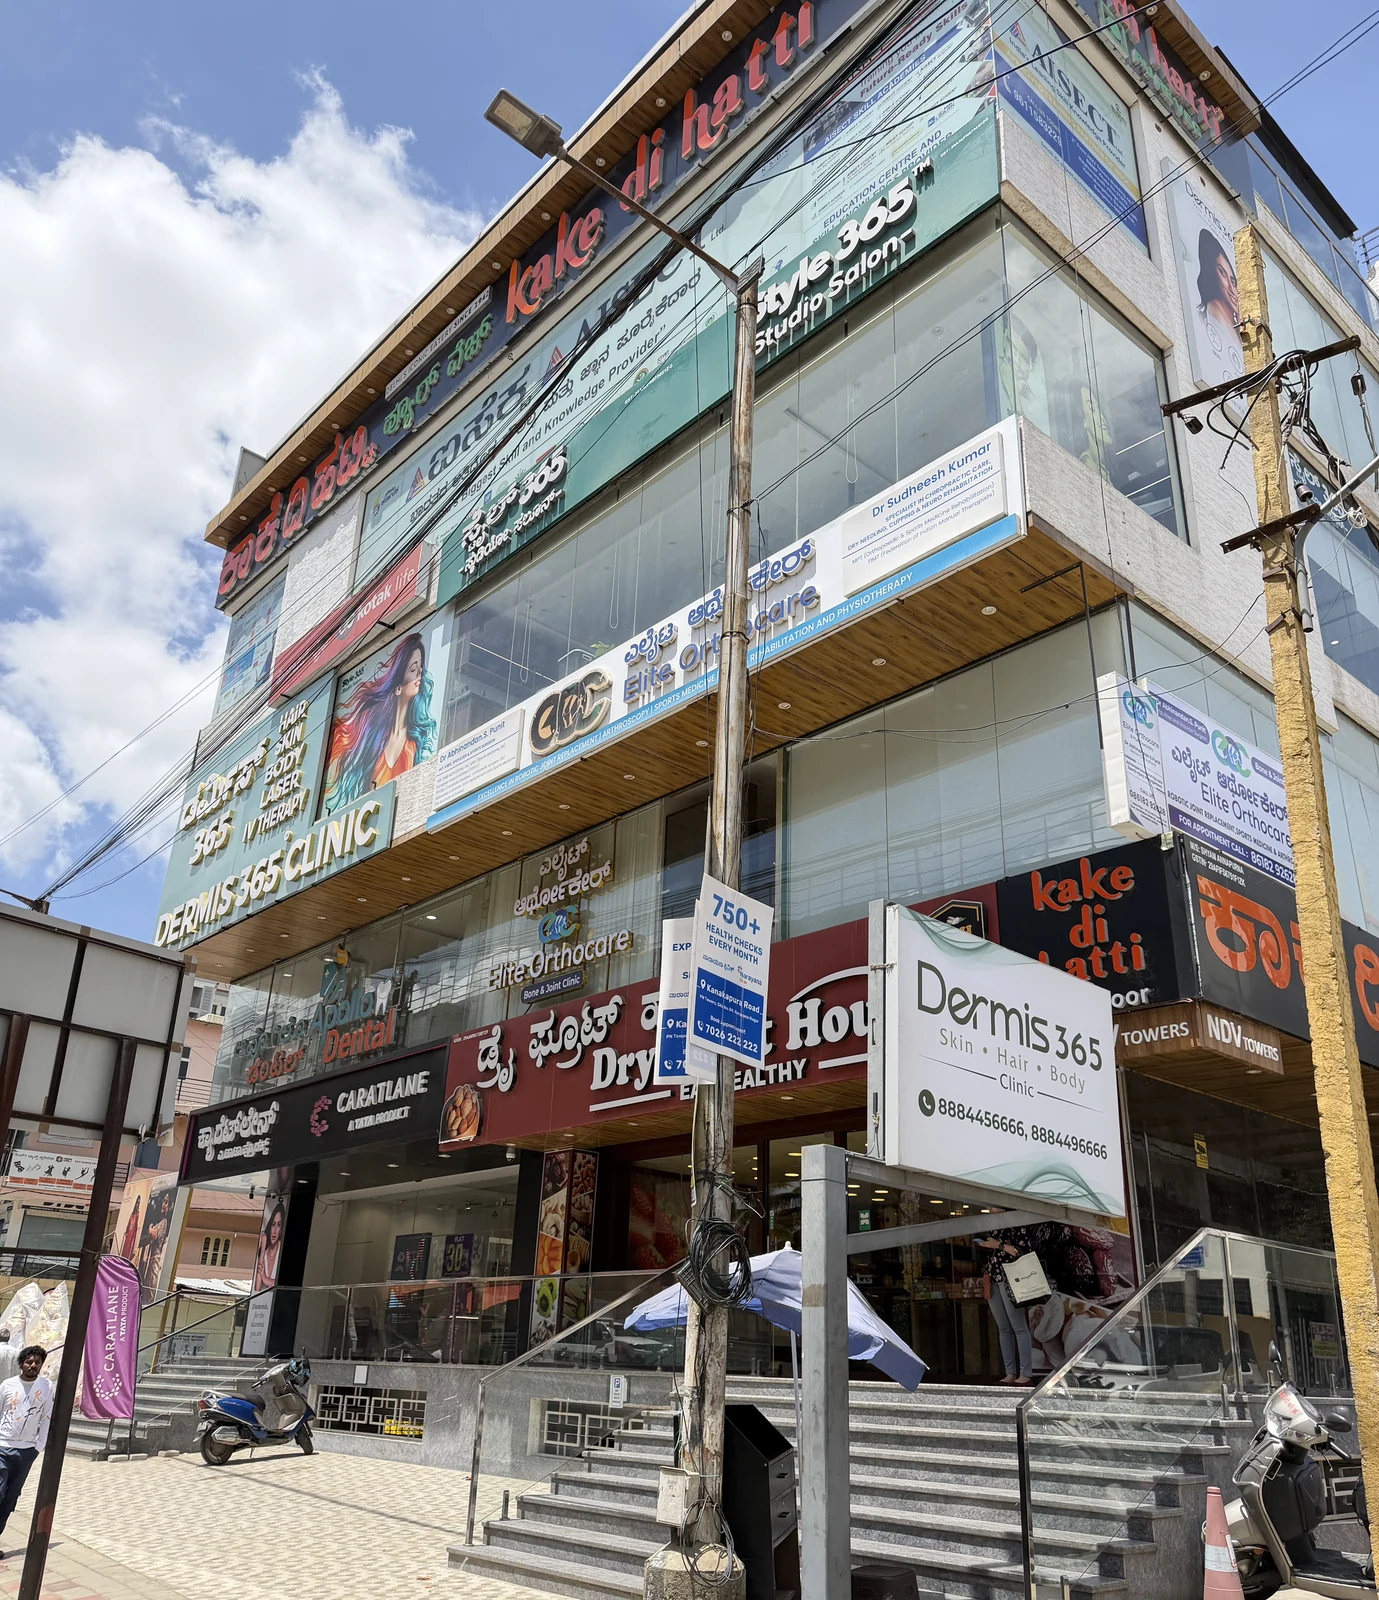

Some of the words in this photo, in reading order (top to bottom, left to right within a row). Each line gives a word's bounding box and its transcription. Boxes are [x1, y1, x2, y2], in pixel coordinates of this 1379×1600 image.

[824, 118, 852, 145] AISECT
[853, 98, 876, 121] SKILL
[877, 53, 926, 100] ACADEMIES
[1031, 43, 1117, 148] AISECT
[506, 207, 603, 323] kake
[620, 127, 665, 212] di
[682, 0, 814, 160] hatti
[823, 180, 876, 229] EDUCATION
[878, 150, 918, 185] CENTRE
[919, 129, 942, 152] AND
[834, 177, 918, 262] 365
[453, 307, 473, 329] SINCE
[522, 433, 542, 451] and
[544, 379, 605, 435] Knowledge
[871, 503, 885, 518] Dr
[887, 467, 946, 509] Sudheesh
[948, 441, 992, 474] Kumar
[885, 502, 917, 523] SPECIALIST
[917, 497, 924, 506] IN
[924, 470, 971, 500] CHIROPRACTIC
[847, 540, 859, 551] DRY
[888, 511, 915, 528] CUPPING
[922, 494, 943, 510] NEURO
[943, 465, 994, 498] REHABILITATION
[905, 522, 923, 537] Sports
[924, 507, 951, 526] Medicine
[938, 511, 961, 527] Manual
[624, 662, 673, 702] Elite
[679, 585, 817, 670] Ortocare
[477, 783, 508, 802] EXCELLENCE
[514, 765, 540, 783] ROBOTIC
[557, 735, 599, 761] REPLACEMENT
[601, 707, 650, 743] ARTHROSCOPY
[653, 692, 681, 713] SPORTS
[681, 674, 716, 698] MEDICINE
[749, 622, 815, 663] REHABILITATION
[816, 613, 832, 630] AND
[836, 571, 914, 622] PHYSIOTHERAPY
[279, 700, 309, 734] HAIR
[489, 720, 506, 736] Punit
[276, 723, 304, 757] SKIN
[264, 743, 307, 785] BODY
[1254, 762, 1267, 776] Bone
[260, 770, 305, 810] LASER
[1167, 790, 1189, 810] ROBOTIC
[1189, 800, 1204, 816] JOINT
[242, 821, 258, 844] IV
[258, 788, 310, 835] THERAPY
[1201, 782, 1229, 814] Elite
[1232, 800, 1292, 847] Orthocare
[189, 809, 235, 866] 365
[1178, 814, 1192, 828] FOR
[1192, 819, 1230, 849] APPOITMENT
[1250, 851, 1274, 874] 86182
[154, 875, 238, 948] DERMIS
[234, 849, 285, 908] 365
[284, 800, 381, 882] CLINIC
[1030, 857, 1135, 912] kake
[712, 893, 761, 935] 750+
[1068, 903, 1108, 948] di
[705, 921, 733, 942] HEALTH
[734, 934, 763, 956] CHECKS
[708, 935, 732, 954] EVERY
[733, 946, 759, 965] MONTH
[486, 961, 526, 992] Elite
[529, 929, 631, 978] Orthocare
[739, 970, 763, 987] Narayana
[523, 989, 540, 1000] Bone
[545, 980, 561, 994] Joint
[562, 974, 581, 988] Clinic
[706, 982, 743, 1008] Kanakapura
[743, 1000, 760, 1015] Road
[308, 988, 374, 1044] Apollo
[323, 1007, 396, 1064] Dental
[710, 1014, 721, 1026] Book
[917, 959, 1051, 1054] Dermis
[1055, 1024, 1103, 1072] 365
[1120, 1021, 1190, 1047] TOWERS
[705, 1024, 726, 1040] 7026
[727, 1031, 742, 1047] 222
[743, 1038, 759, 1054] 222
[1206, 1013, 1242, 1049] NDV
[1241, 1034, 1280, 1063] TOWERS
[590, 1047, 656, 1091] Dry
[733, 1057, 808, 1091] EALTHY
[939, 1027, 973, 1055] Skin
[997, 1046, 1029, 1073] Hair
[1050, 1064, 1086, 1095] Body
[336, 1070, 431, 1113] CARATLANE
[999, 1073, 1035, 1098] Clinic
[347, 1119, 355, 1132] A
[355, 1114, 377, 1131] TATA
[376, 1105, 411, 1126] PRODUCT
[1031, 1124, 1108, 1160] 8884496666
[121, 1285, 129, 1316] PRODUCT
[103, 1285, 119, 1372] CARATLANE
[119, 1316, 127, 1335] TATA
[119, 1334, 126, 1342] A
